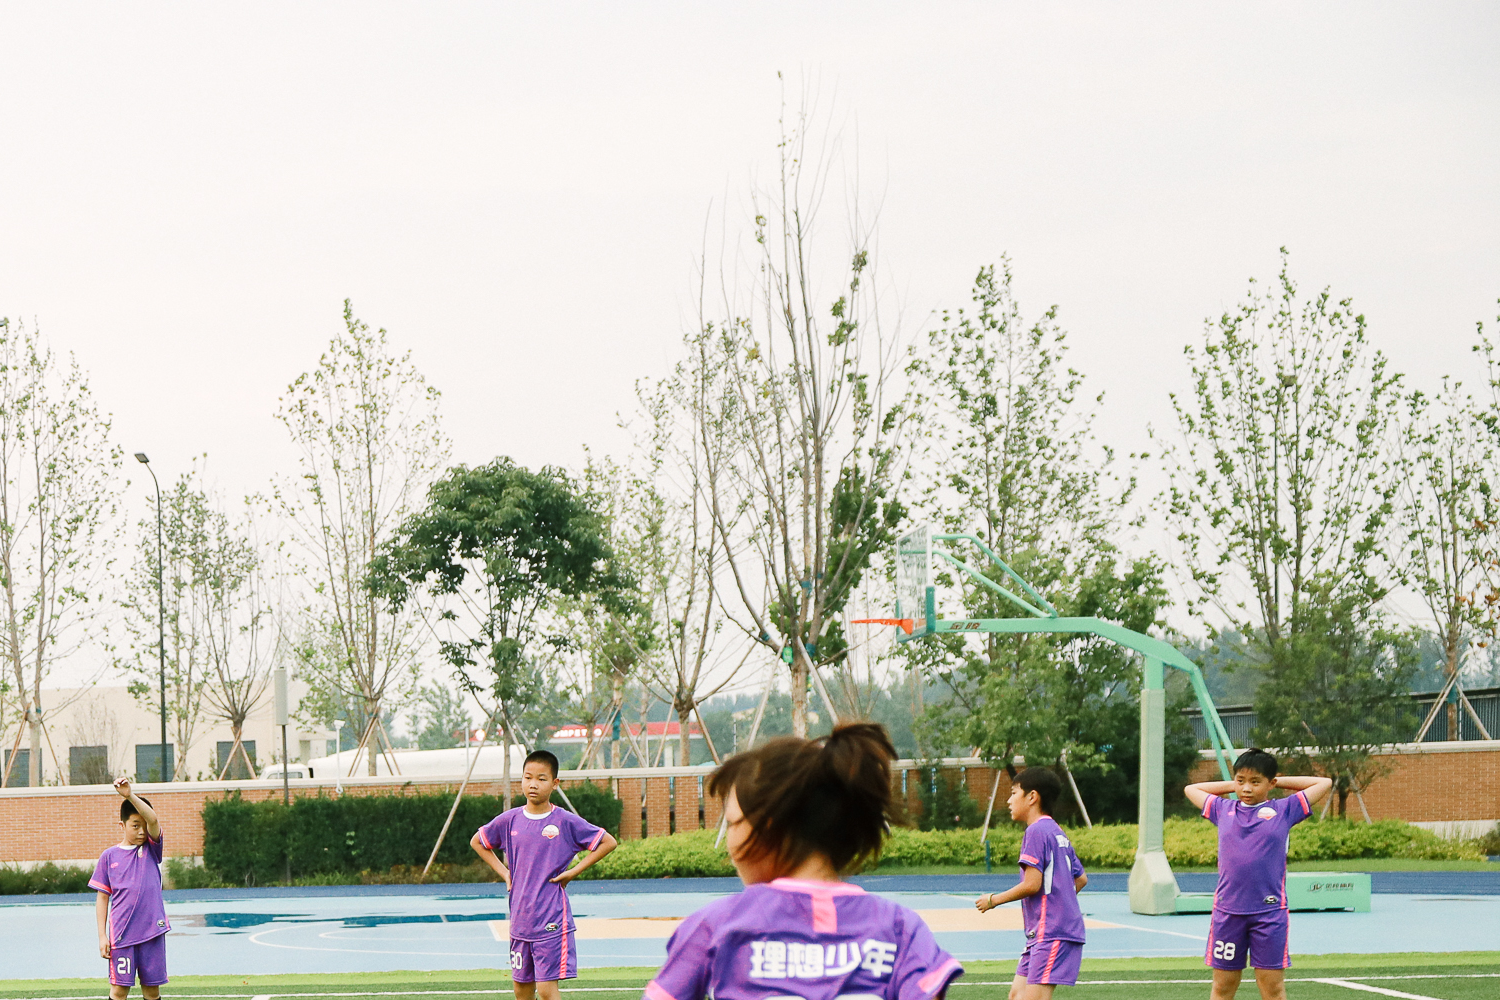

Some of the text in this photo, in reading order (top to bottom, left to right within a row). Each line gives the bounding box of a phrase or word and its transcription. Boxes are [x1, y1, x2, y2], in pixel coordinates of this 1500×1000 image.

[749, 938, 898, 979] 理想少年
[1213, 940, 1236, 961] 28
[116, 956, 131, 975] 21
